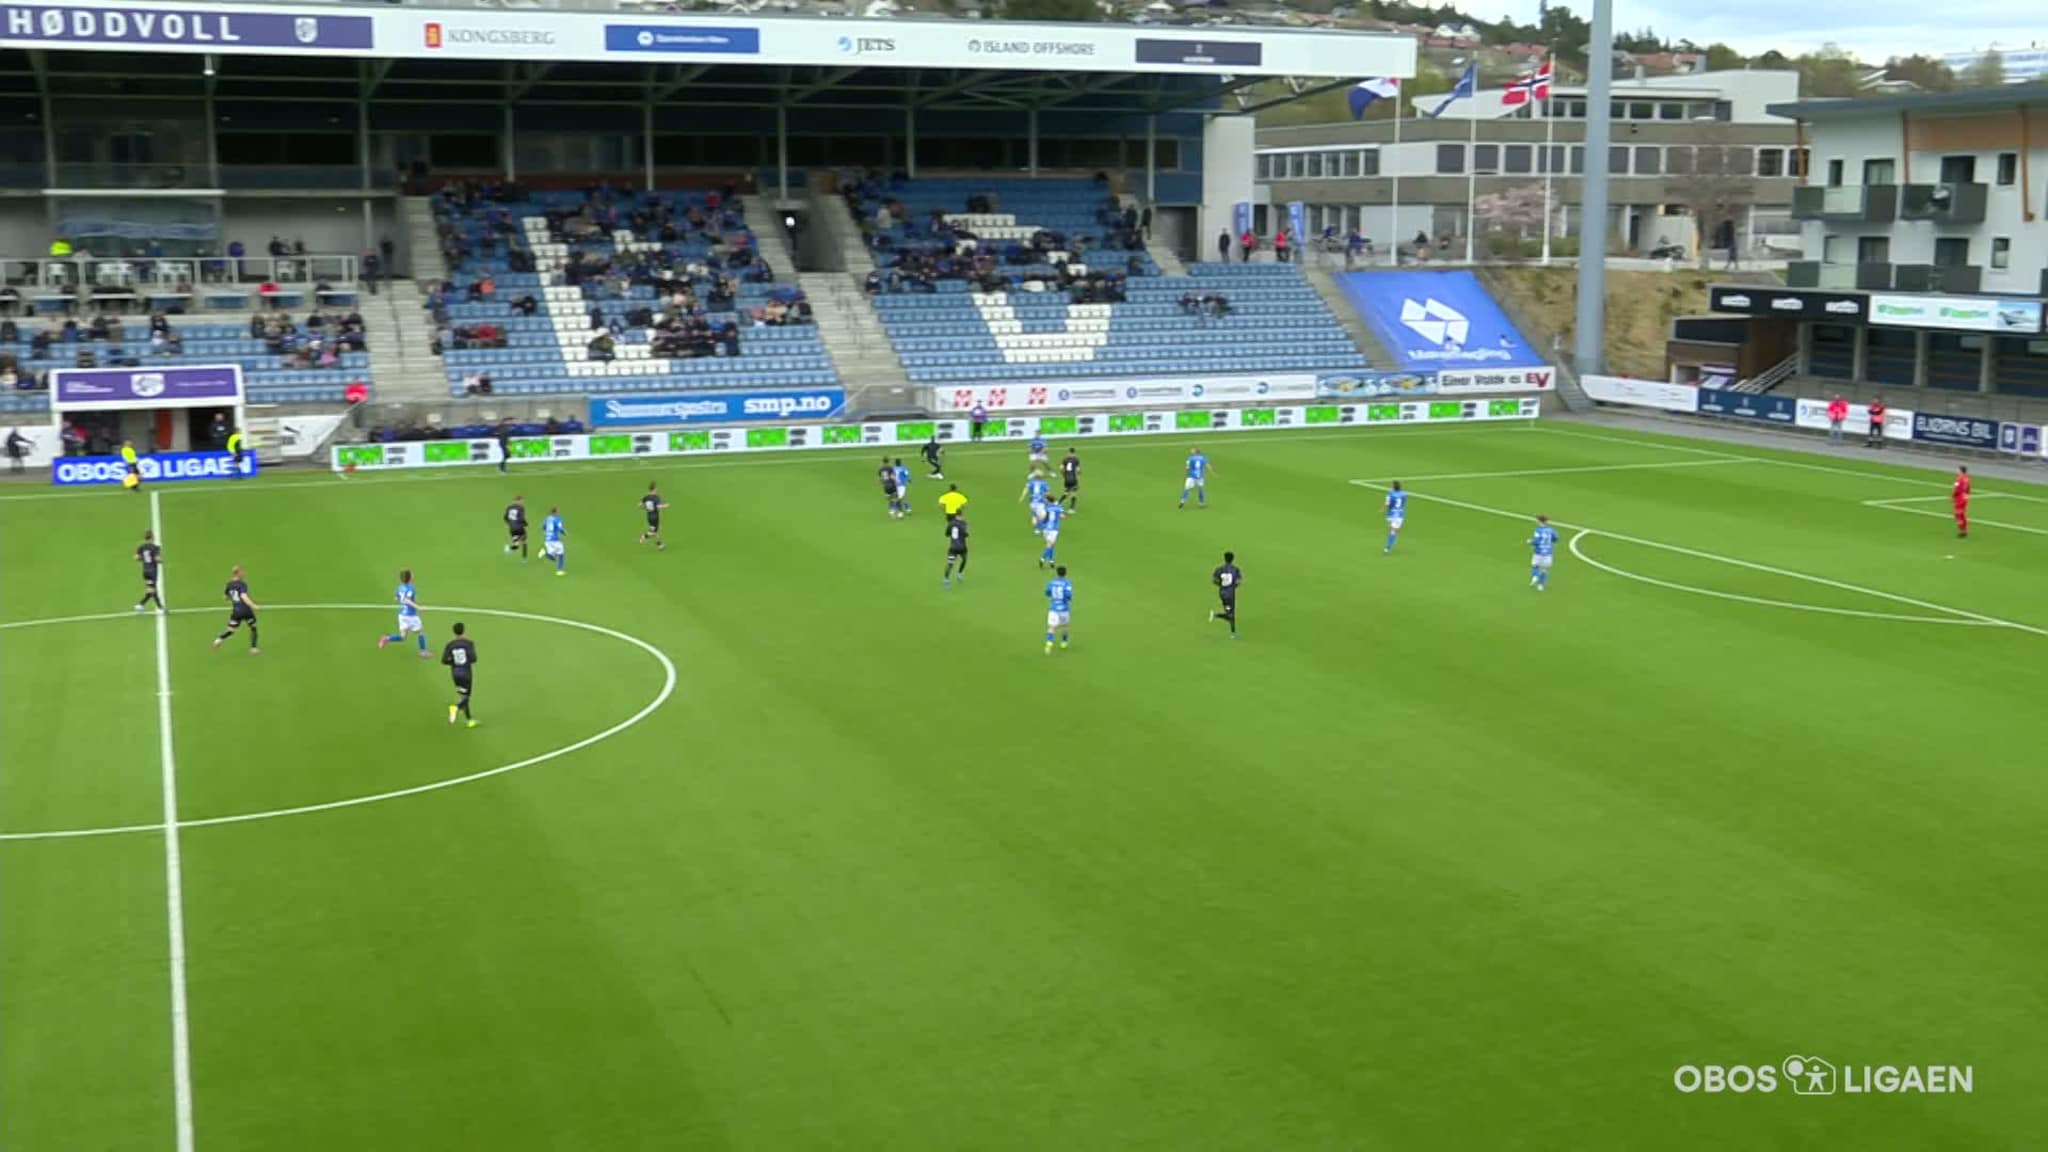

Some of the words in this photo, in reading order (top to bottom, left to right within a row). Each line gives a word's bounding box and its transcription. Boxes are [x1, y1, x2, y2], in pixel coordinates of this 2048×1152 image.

[8, 8, 241, 41] HØDDVOLL
[447, 29, 557, 45] KONGSBERG
[856, 37, 897, 55] JETS
[984, 39, 1029, 55] ISLAND
[1033, 41, 1095, 56] OFFSHORE
[743, 396, 832, 417] smp.no
[57, 461, 129, 482] OBOS
